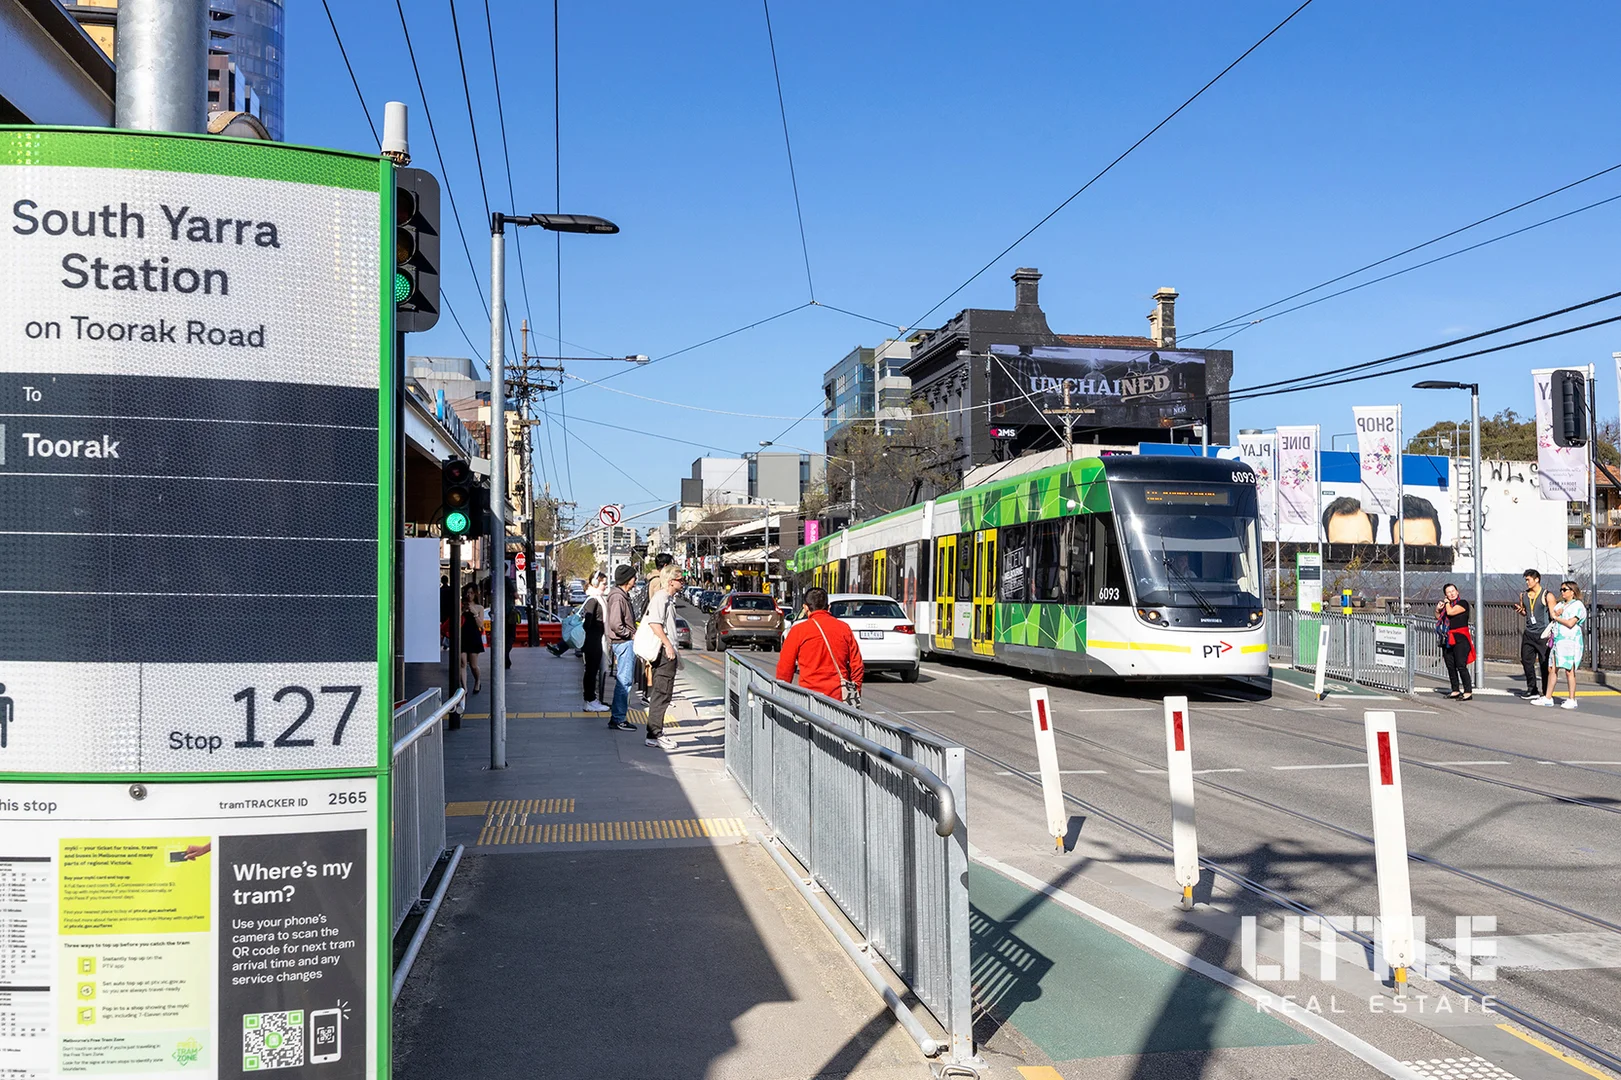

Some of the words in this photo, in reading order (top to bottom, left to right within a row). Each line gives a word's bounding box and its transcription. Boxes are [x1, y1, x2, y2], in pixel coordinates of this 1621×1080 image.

[12, 199, 144, 239] South
[160, 203, 281, 249] Yarra
[61, 253, 229, 296] Station
[25, 320, 61, 339] on
[70, 316, 176, 344] Toorak
[187, 320, 265, 348] Road
[22, 386, 42, 402] To
[22, 432, 120, 459] Toorak
[1232, 471, 1256, 484] 6093
[1099, 587, 1120, 600] 6093
[168, 731, 222, 754] Stop
[233, 686, 362, 748] 127
[23, 800, 57, 814] stop
[218, 799, 295, 810] tramTRACKER
[298, 798, 308, 807] ID
[328, 792, 367, 806] 2565
[233, 860, 318, 881] Where's
[322, 862, 353, 880] my
[232, 885, 295, 905] tram?
[232, 919, 254, 929] Use
[257, 919, 282, 930] your
[284, 914, 327, 928] phone's
[232, 932, 274, 943] camera
[277, 932, 289, 940] to
[292, 929, 318, 939] scan
[321, 927, 339, 936] the
[232, 946, 249, 958] QR
[252, 945, 280, 956] code
[283, 943, 299, 954] for
[302, 942, 327, 952] next
[329, 940, 355, 949] tram
[232, 959, 267, 971] arrival
[270, 958, 295, 969] time
[298, 955, 318, 966] and
[321, 955, 340, 966] any
[232, 973, 274, 985] service
[276, 970, 323, 982] changes
